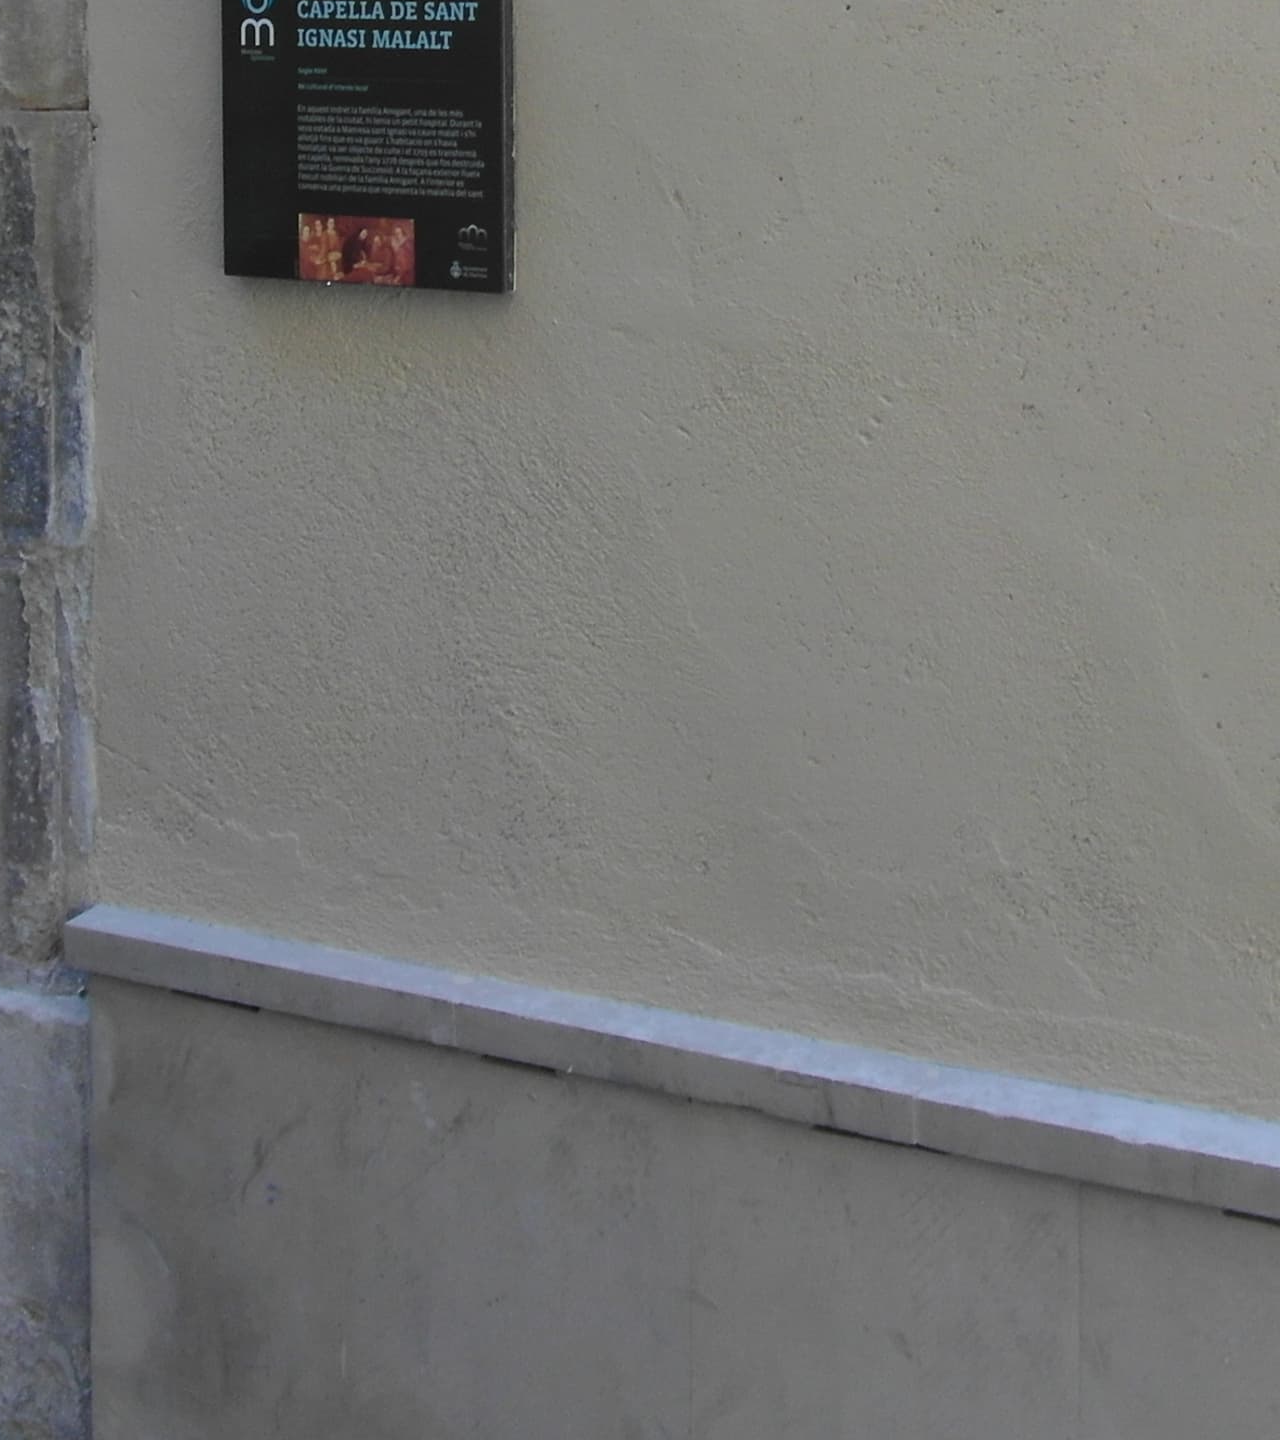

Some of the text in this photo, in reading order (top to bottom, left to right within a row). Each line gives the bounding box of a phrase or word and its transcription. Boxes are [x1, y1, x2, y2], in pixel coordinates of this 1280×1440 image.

[297, 0, 479, 22] CAPELLA DE SANT
[297, 28, 453, 50] IGNASI MALALT
